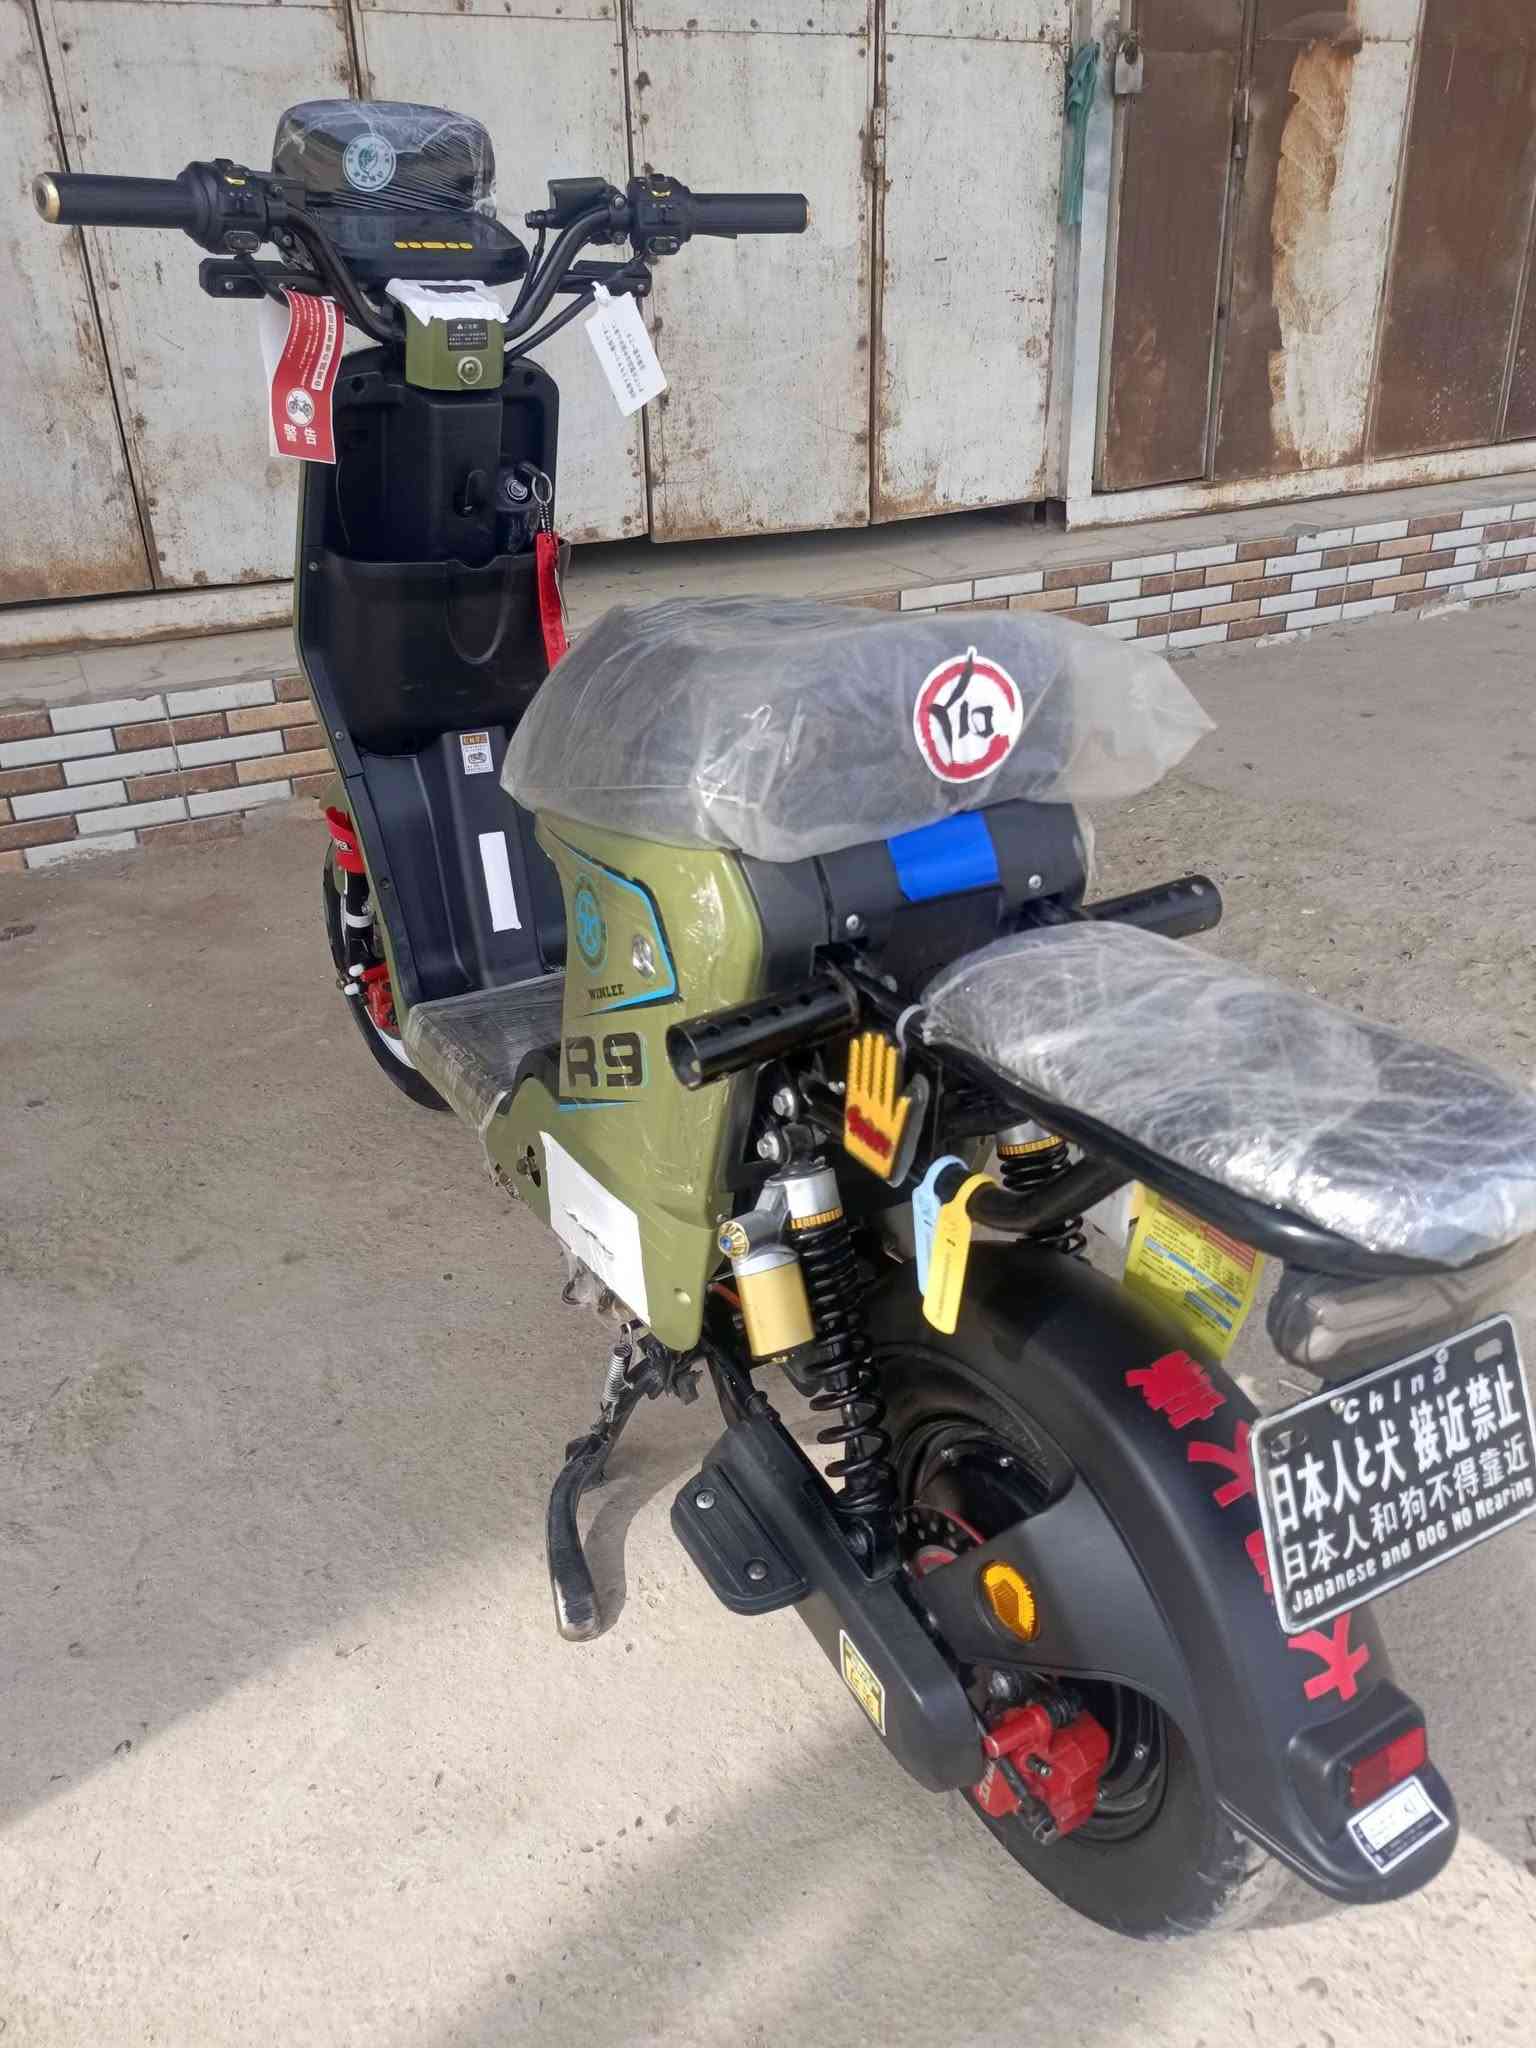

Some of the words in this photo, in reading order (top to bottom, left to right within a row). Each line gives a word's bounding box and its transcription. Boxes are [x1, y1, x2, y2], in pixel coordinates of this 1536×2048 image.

[565, 1031, 644, 1088] R9
[1268, 1419, 1407, 1539] 日本人と犬
[1409, 1364, 1521, 1474] 接近禁止
[1281, 1432, 1530, 1591] 日本人和狗不得靠近
[1292, 1557, 1378, 1613] Japanese
[1382, 1538, 1412, 1570] and
[1415, 1519, 1448, 1551] DOG
[1451, 1506, 1474, 1533] NO
